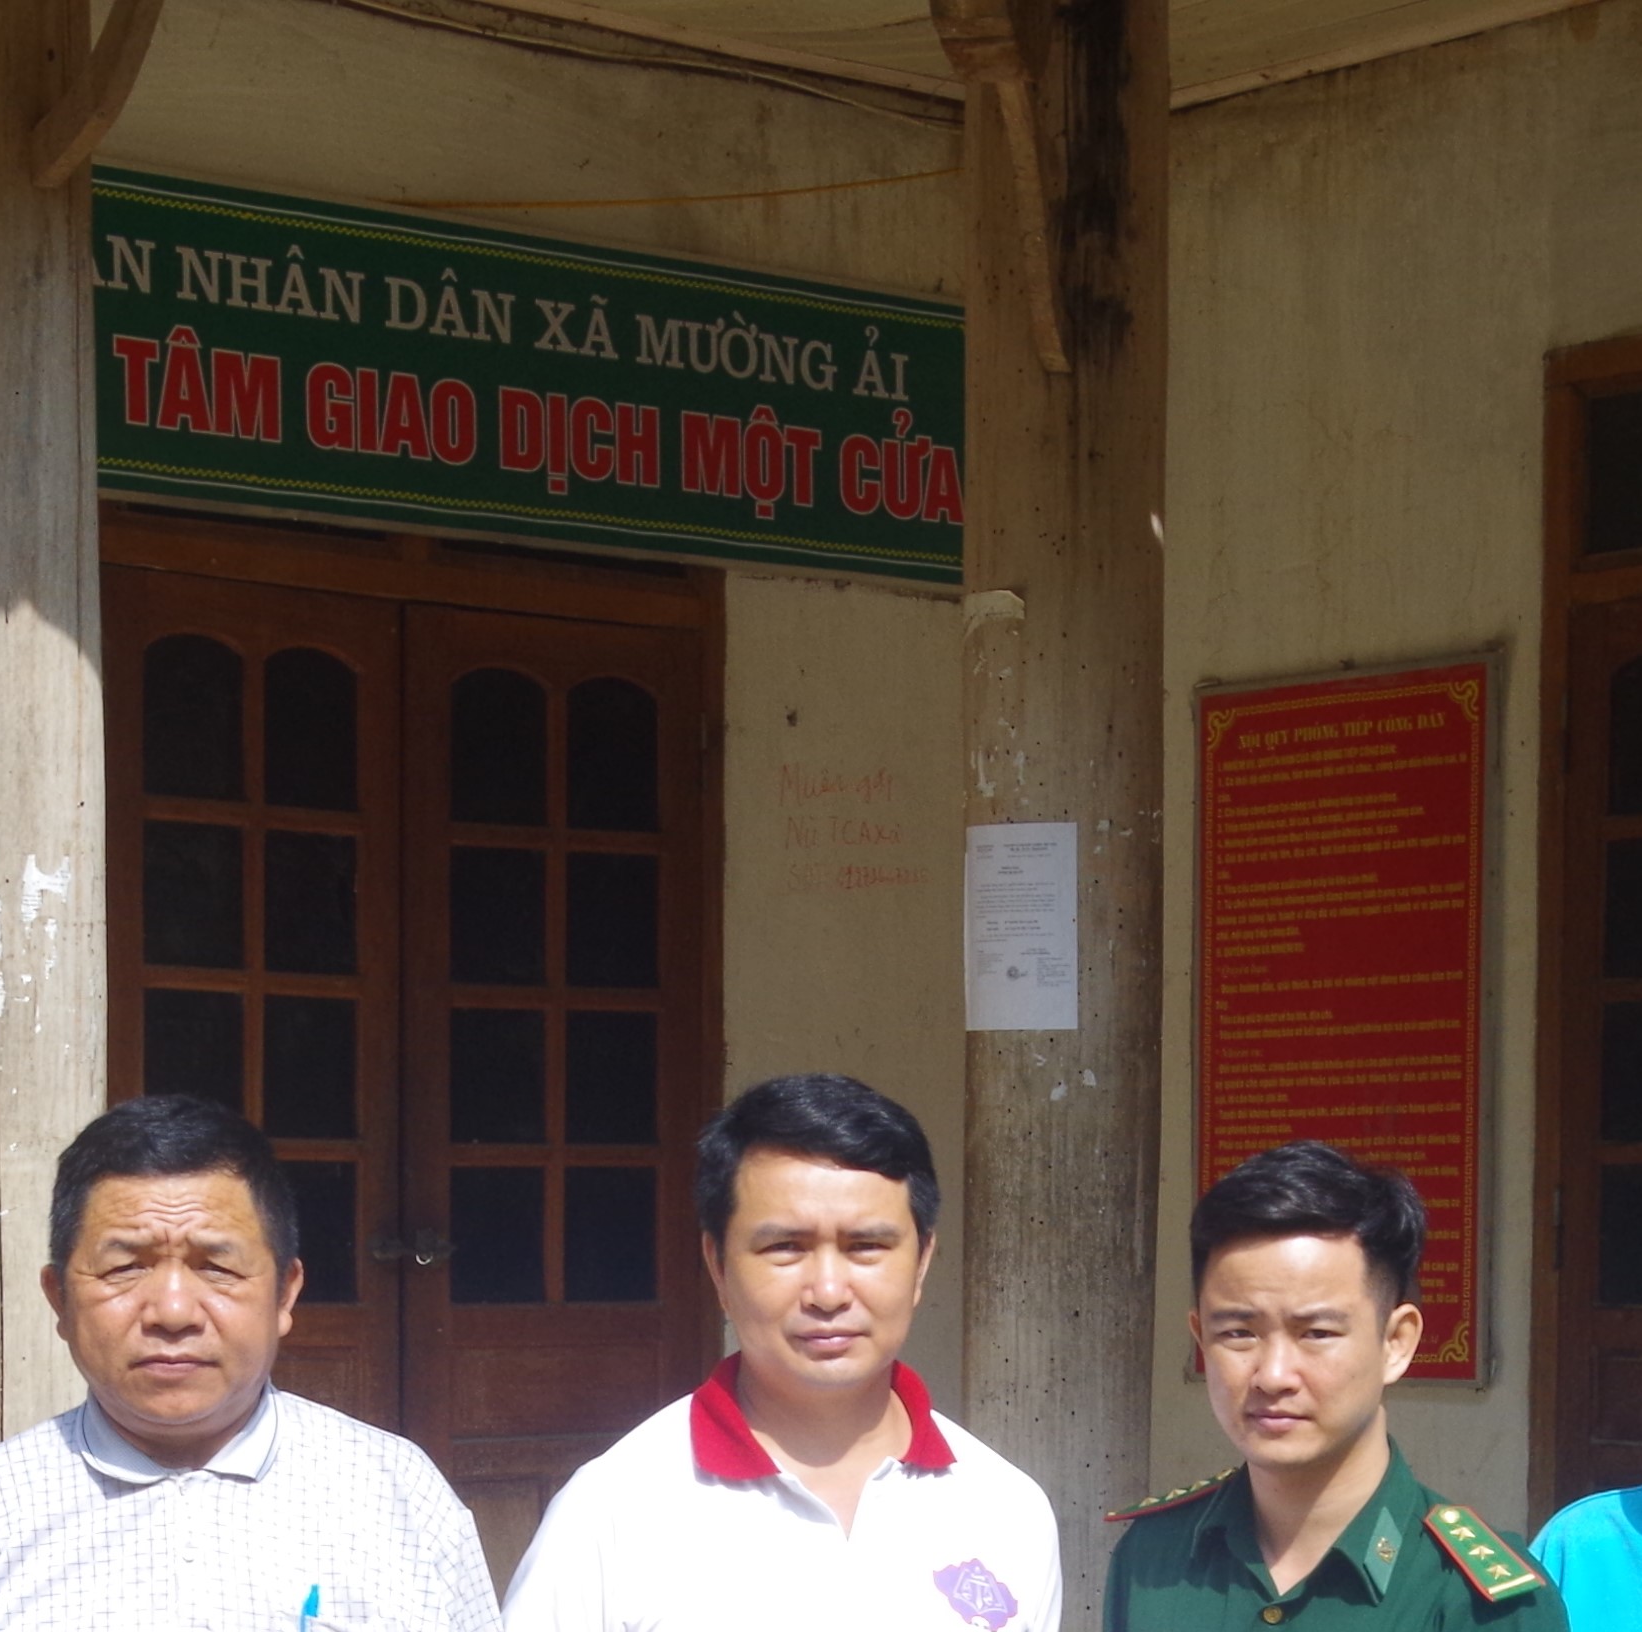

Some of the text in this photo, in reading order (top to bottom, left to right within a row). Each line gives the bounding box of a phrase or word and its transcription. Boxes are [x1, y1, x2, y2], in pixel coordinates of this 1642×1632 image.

[175, 244, 366, 325] NHÂN
[384, 266, 515, 344] DÂN
[533, 294, 619, 360] XÃ
[634, 309, 838, 392] MƯỜNG
[852, 324, 910, 401] ẢI
[112, 325, 282, 443] TÂM
[305, 361, 478, 466] GIAO
[498, 385, 660, 495] DỊCH
[680, 404, 822, 520] MỘT
[839, 407, 965, 525] CỬA
